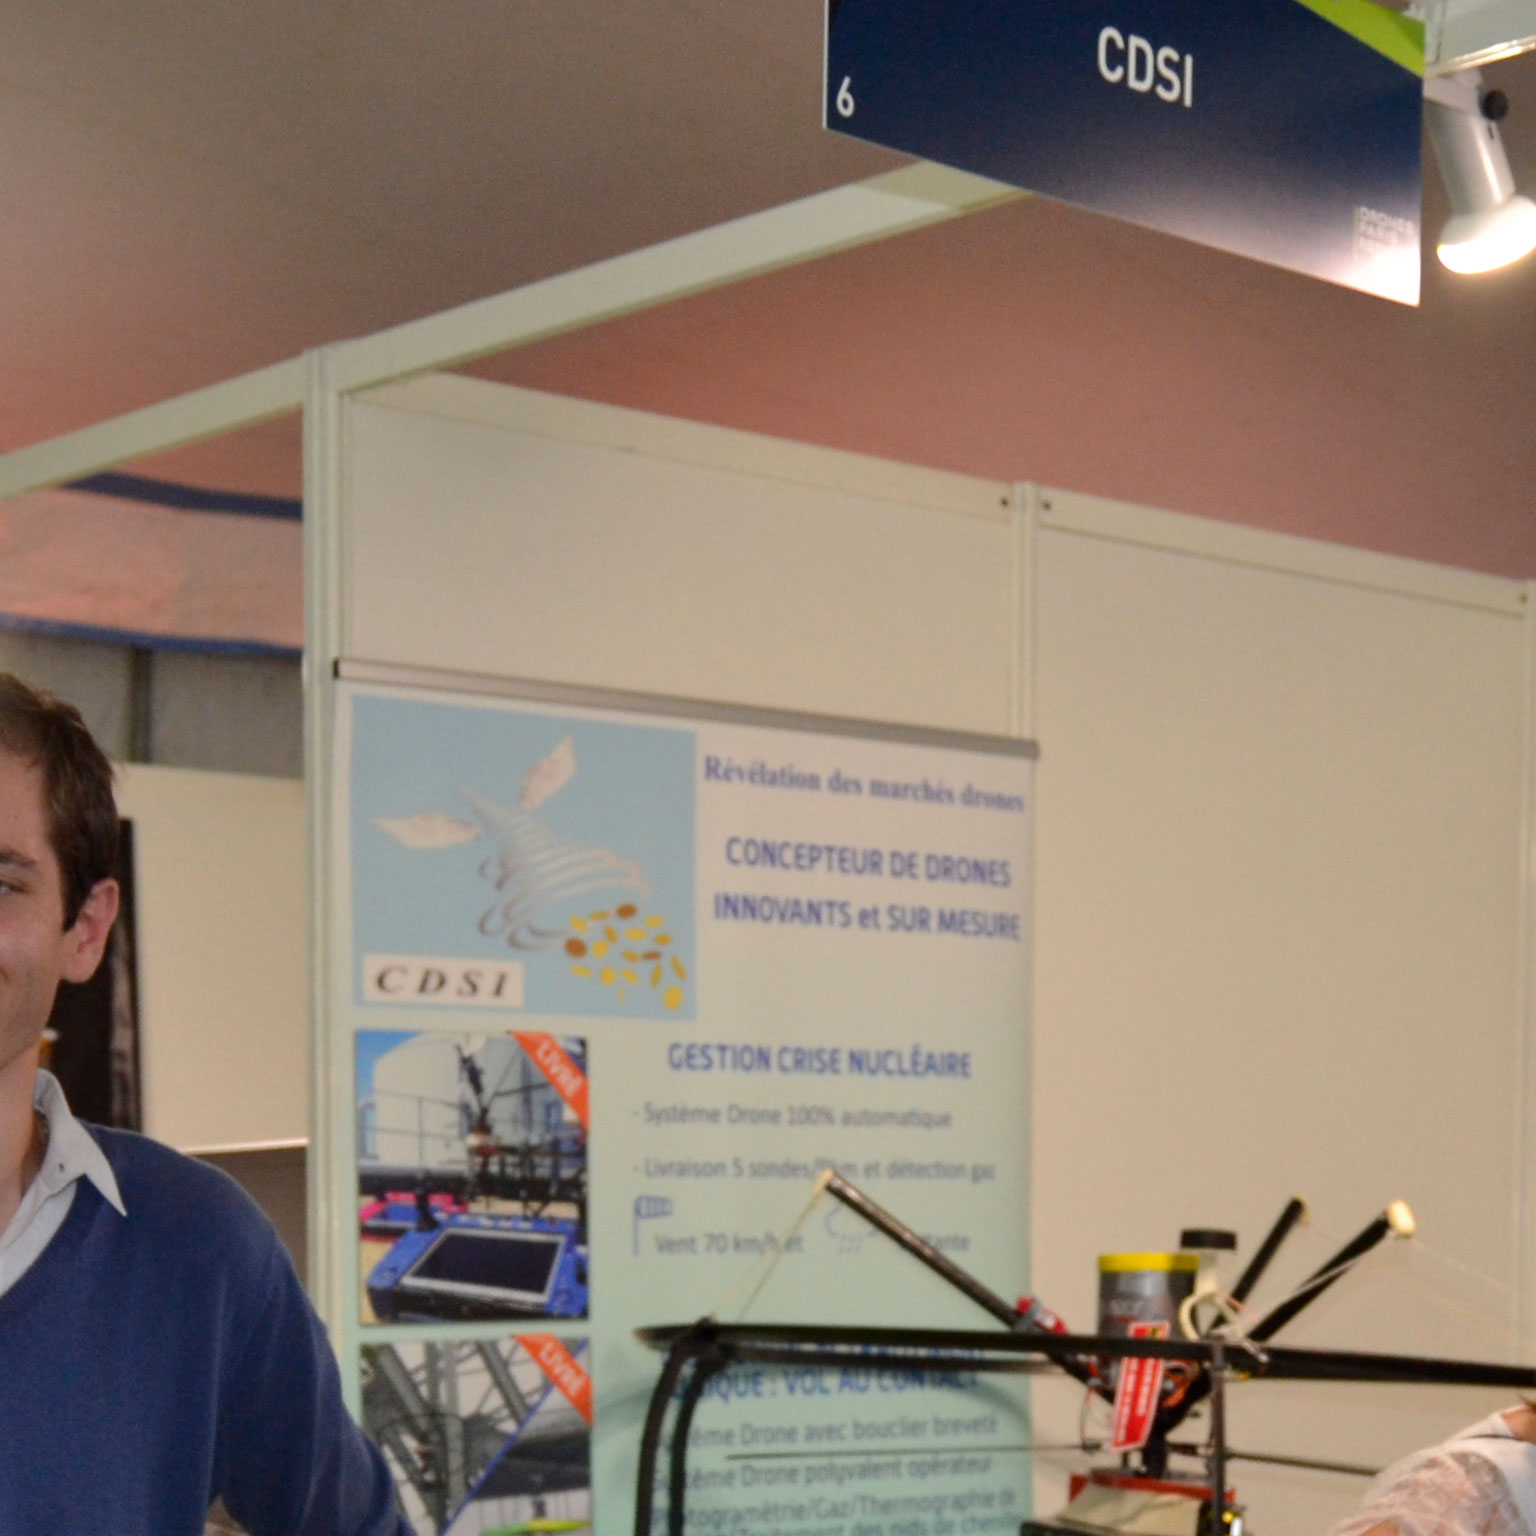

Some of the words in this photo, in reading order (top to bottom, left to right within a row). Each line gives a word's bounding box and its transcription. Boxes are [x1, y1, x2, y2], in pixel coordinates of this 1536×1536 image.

[1097, 26, 1193, 107] CDSI
[836, 76, 855, 118] 6
[704, 754, 821, 791] Révélation
[828, 769, 863, 796] des
[869, 777, 955, 805] marchés
[961, 785, 1025, 813] drones
[726, 836, 884, 876] CONCEPTEUR
[890, 850, 920, 879] DE
[926, 854, 1011, 888] DRONES
[715, 893, 851, 928] INNOVANTS
[858, 905, 880, 930] et
[888, 904, 931, 933] SUR
[938, 908, 1021, 941] MESURE
[375, 964, 508, 999] CDSI
[668, 1043, 770, 1073] GESTION
[778, 1045, 841, 1074] CRISE
[849, 1044, 971, 1078] NUCLÉAIRE
[644, 1102, 721, 1127] Système
[728, 1104, 781, 1125] Drone
[787, 1106, 833, 1126] 100%
[841, 1106, 952, 1129] automatique
[644, 1157, 726, 1178] Livraison
[864, 1160, 881, 1178] et
[655, 1234, 696, 1254] Vent
[704, 1233, 727, 1252] 70
[741, 1423, 799, 1446] Drone
[741, 1464, 799, 1487] Drone
